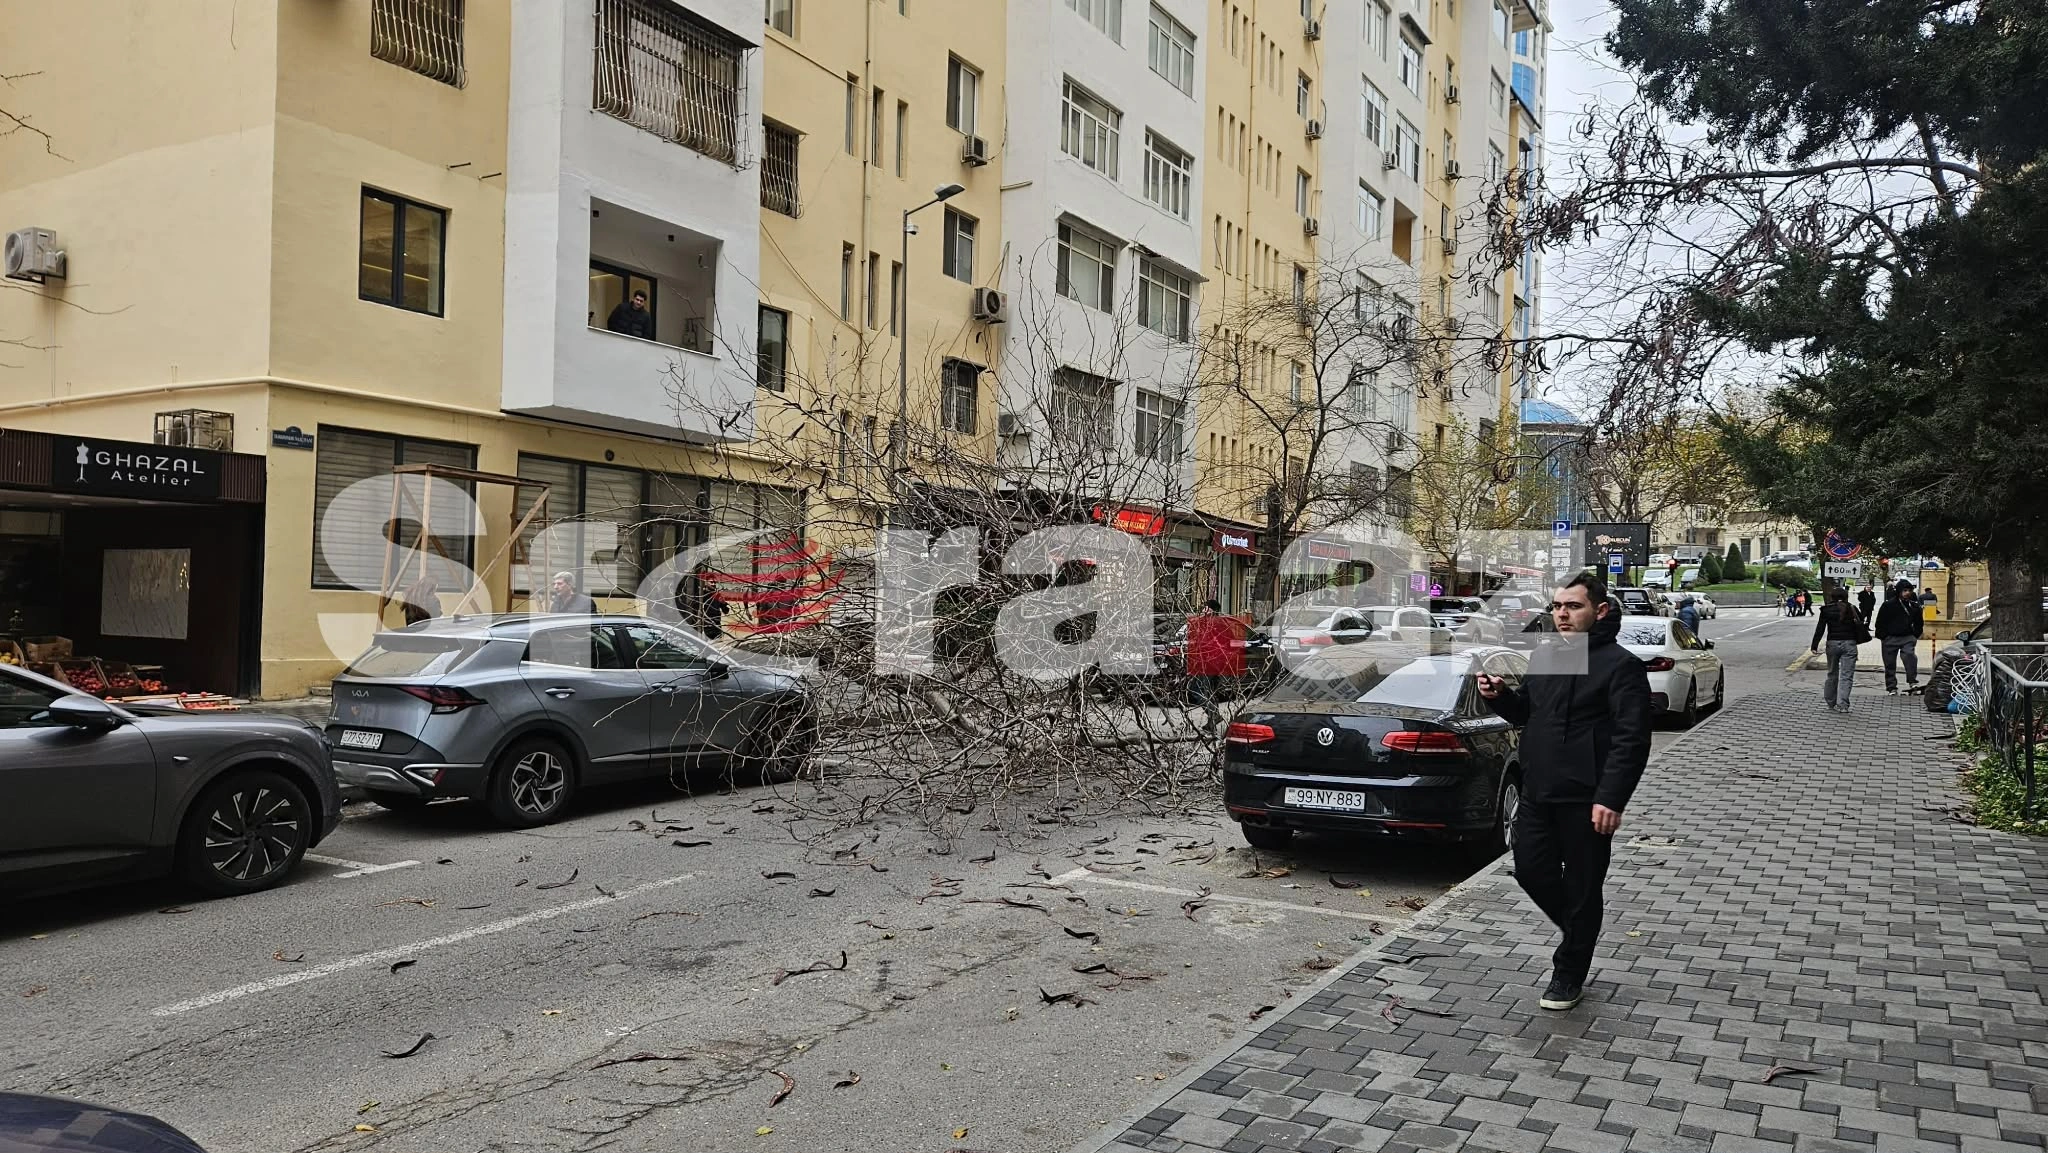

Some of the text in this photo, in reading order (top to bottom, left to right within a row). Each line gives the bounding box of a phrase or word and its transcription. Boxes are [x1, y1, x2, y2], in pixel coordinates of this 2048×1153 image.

[95, 451, 205, 474] GHAZAL
[111, 470, 190, 487] Atelier
[1833, 566, 1845, 574] 60
